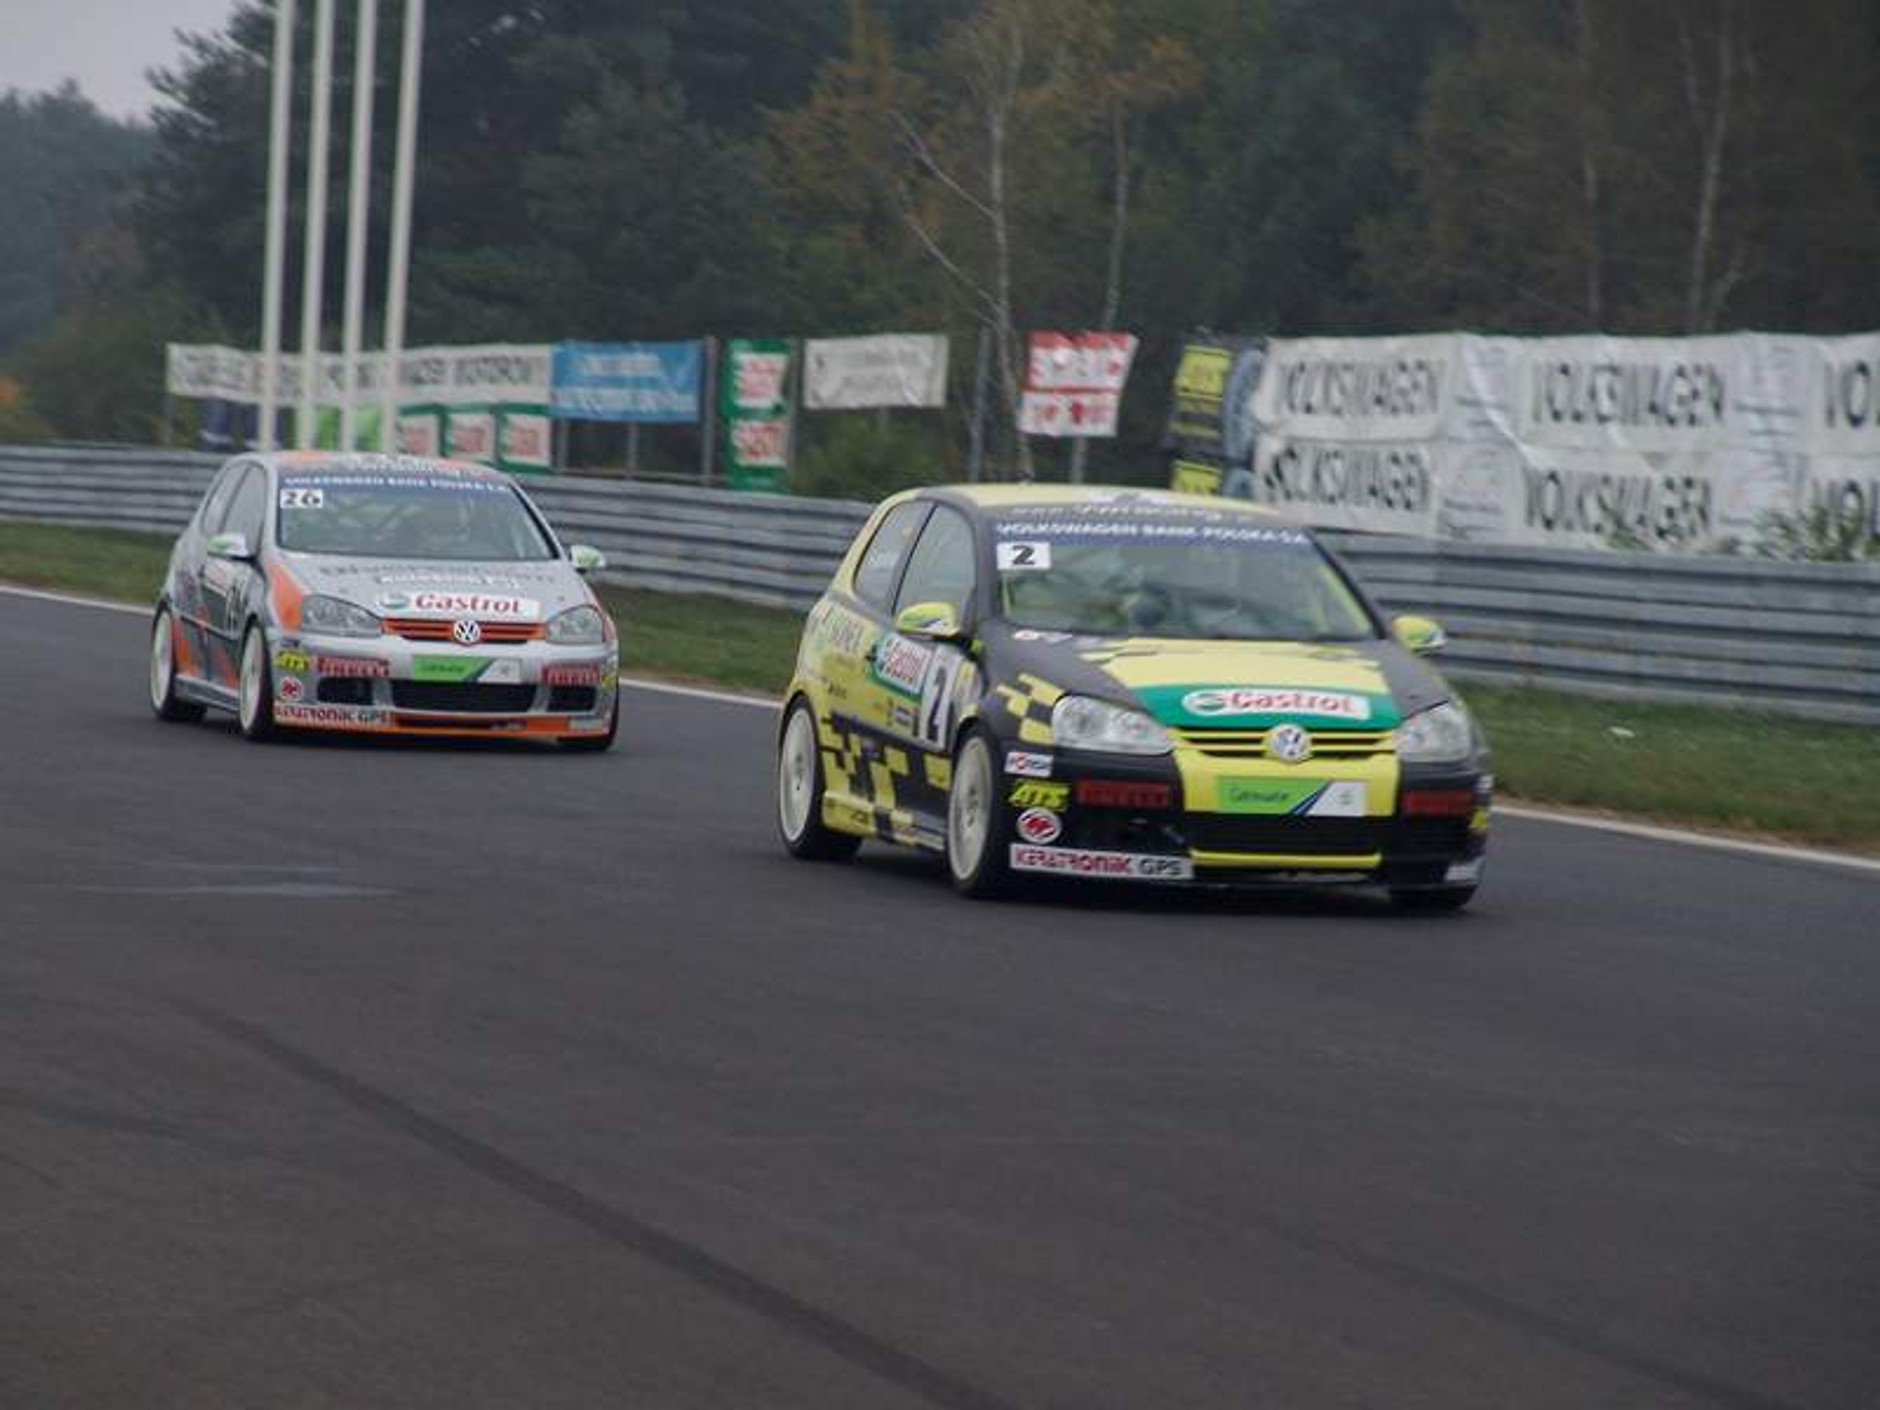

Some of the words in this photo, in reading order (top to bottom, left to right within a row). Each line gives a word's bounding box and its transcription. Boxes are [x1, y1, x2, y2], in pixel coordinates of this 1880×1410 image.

[1278, 359, 1440, 416] VOLKSWAGEN
[1531, 362, 1725, 426] VOLKSWAGEN
[1823, 362, 1880, 428] VO
[285, 490, 322, 506] 26
[1011, 544, 1037, 566] 2
[415, 594, 521, 614] Castrol
[926, 666, 948, 742] 2
[1231, 691, 1355, 715] Castrol
[1137, 857, 1185, 878] GPS
